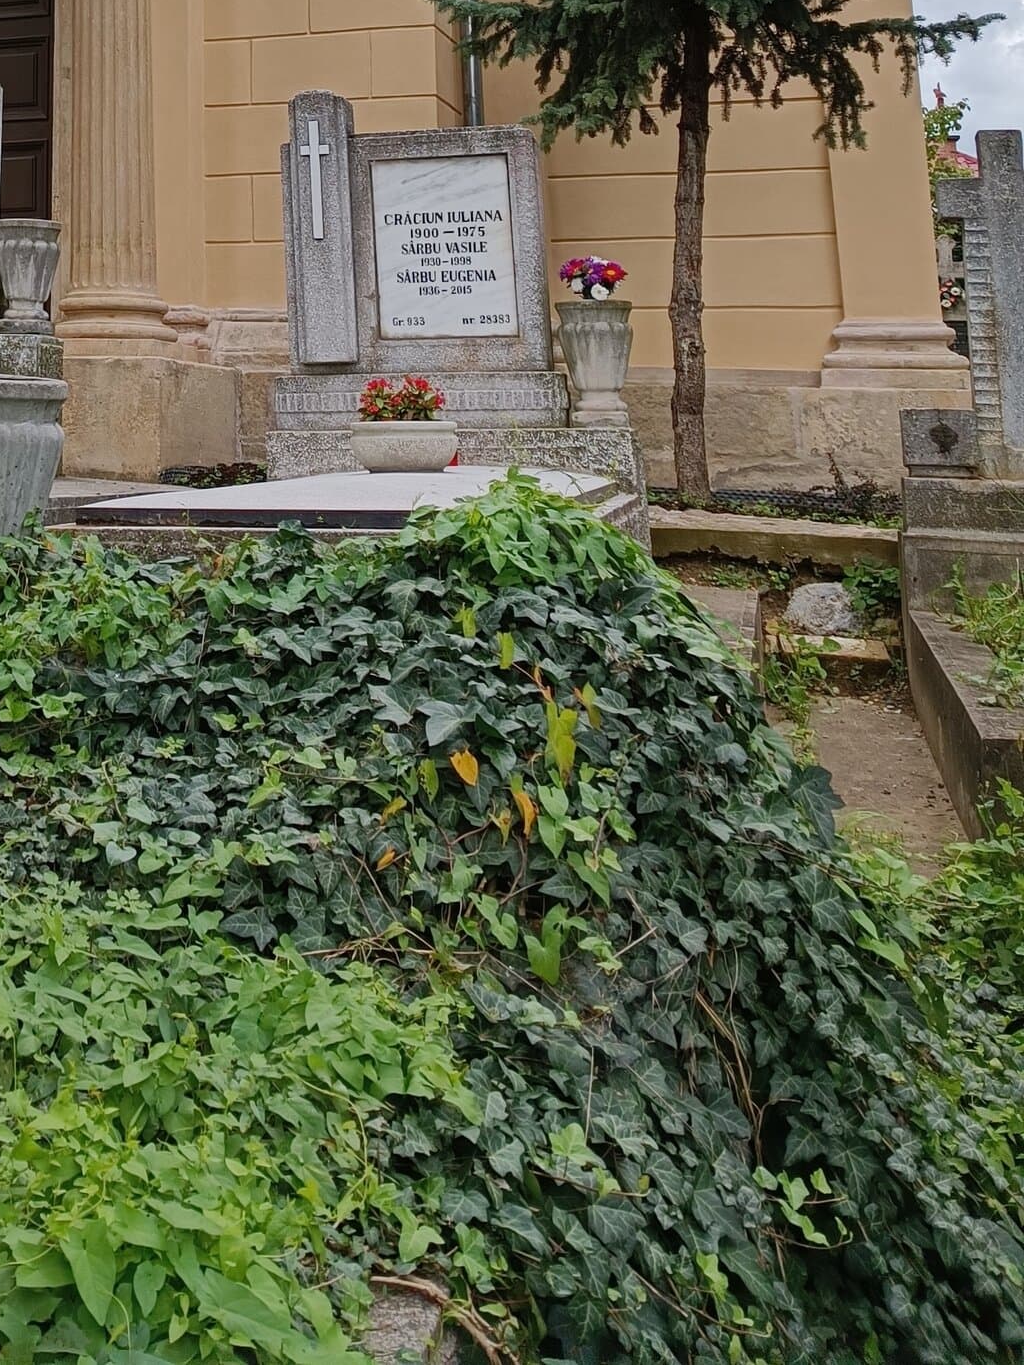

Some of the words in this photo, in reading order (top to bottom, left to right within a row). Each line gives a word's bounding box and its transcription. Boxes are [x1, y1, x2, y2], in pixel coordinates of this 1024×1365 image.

[447, 210, 503, 223] IULIANA
[410, 227, 439, 239] 1900
[457, 226, 486, 237] 1975
[445, 242, 488, 254] VASILE
[441, 269, 497, 282] EUGENIA
